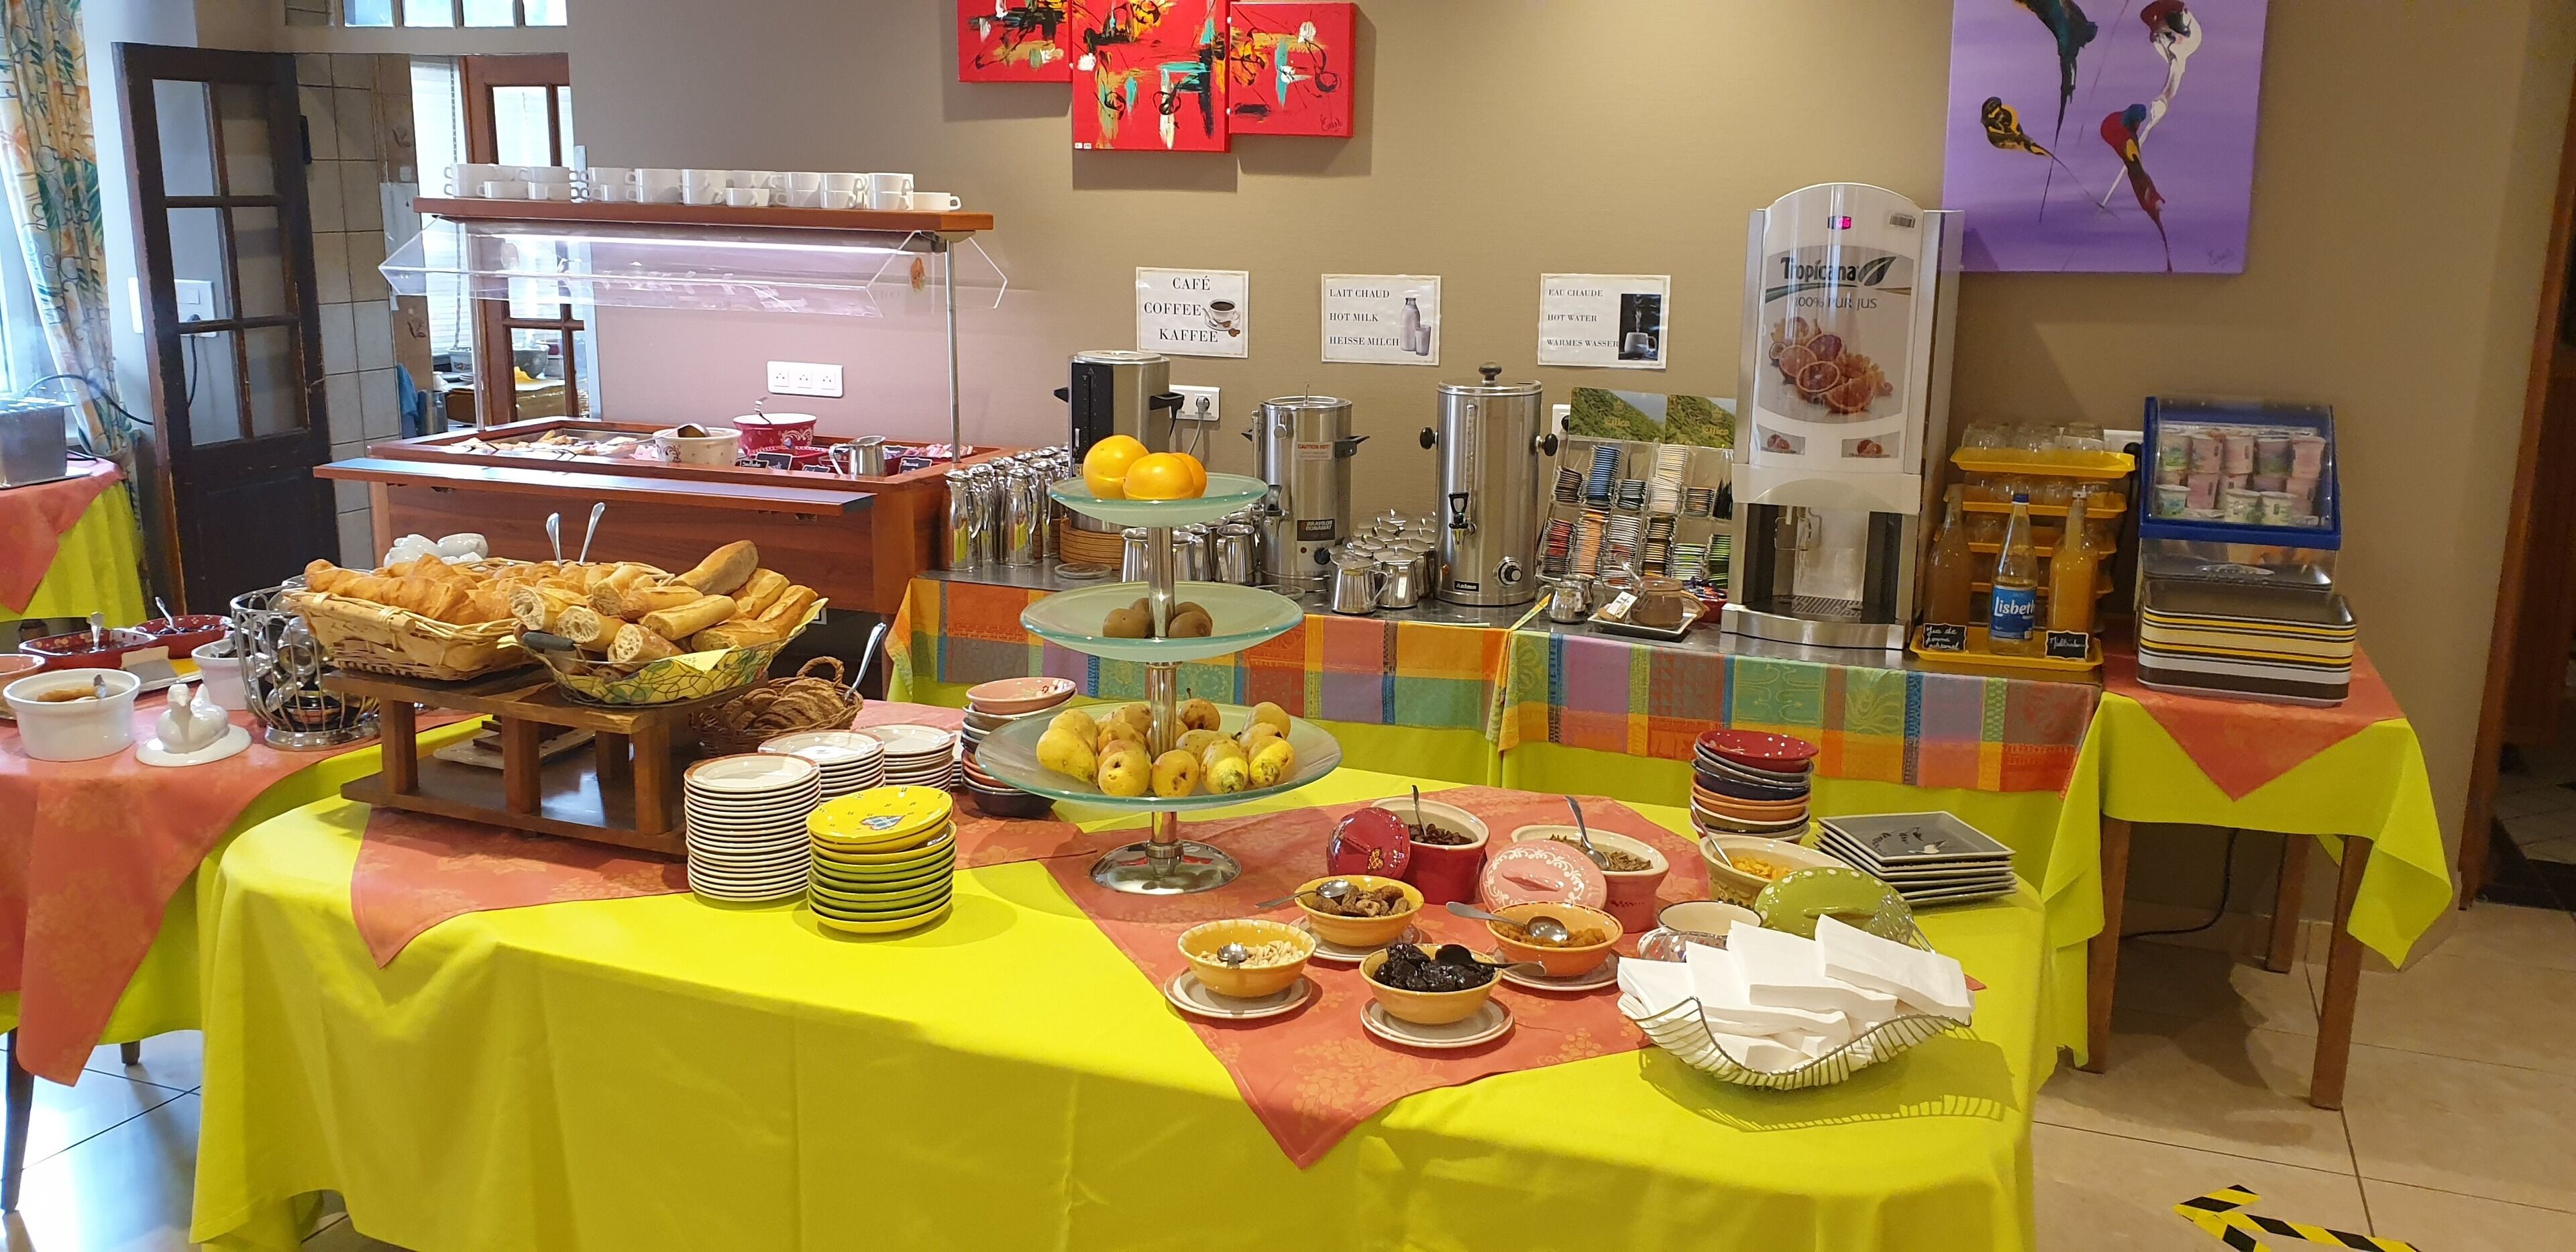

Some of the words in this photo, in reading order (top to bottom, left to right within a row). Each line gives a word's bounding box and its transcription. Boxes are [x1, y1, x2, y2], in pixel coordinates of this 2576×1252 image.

[1173, 276, 1211, 291] CAFÉ
[1330, 289, 1353, 298] LAIT
[1355, 290, 1390, 299] CHAUD
[1567, 289, 1603, 297] CHAUDE
[1144, 302, 1201, 316] COFFEE
[1857, 298, 1877, 311] JUS
[1330, 313, 1350, 321] HOT
[1353, 313, 1379, 322] MILK
[1548, 314, 1565, 322] HOT
[1567, 314, 1597, 322] WATER
[1159, 328, 1218, 343] KAFFEE
[1330, 336, 1365, 346] HEISSE
[1367, 337, 1399, 346] MILCH
[1546, 339, 1583, 347] WARMES
[1585, 340, 1619, 348] WASSER
